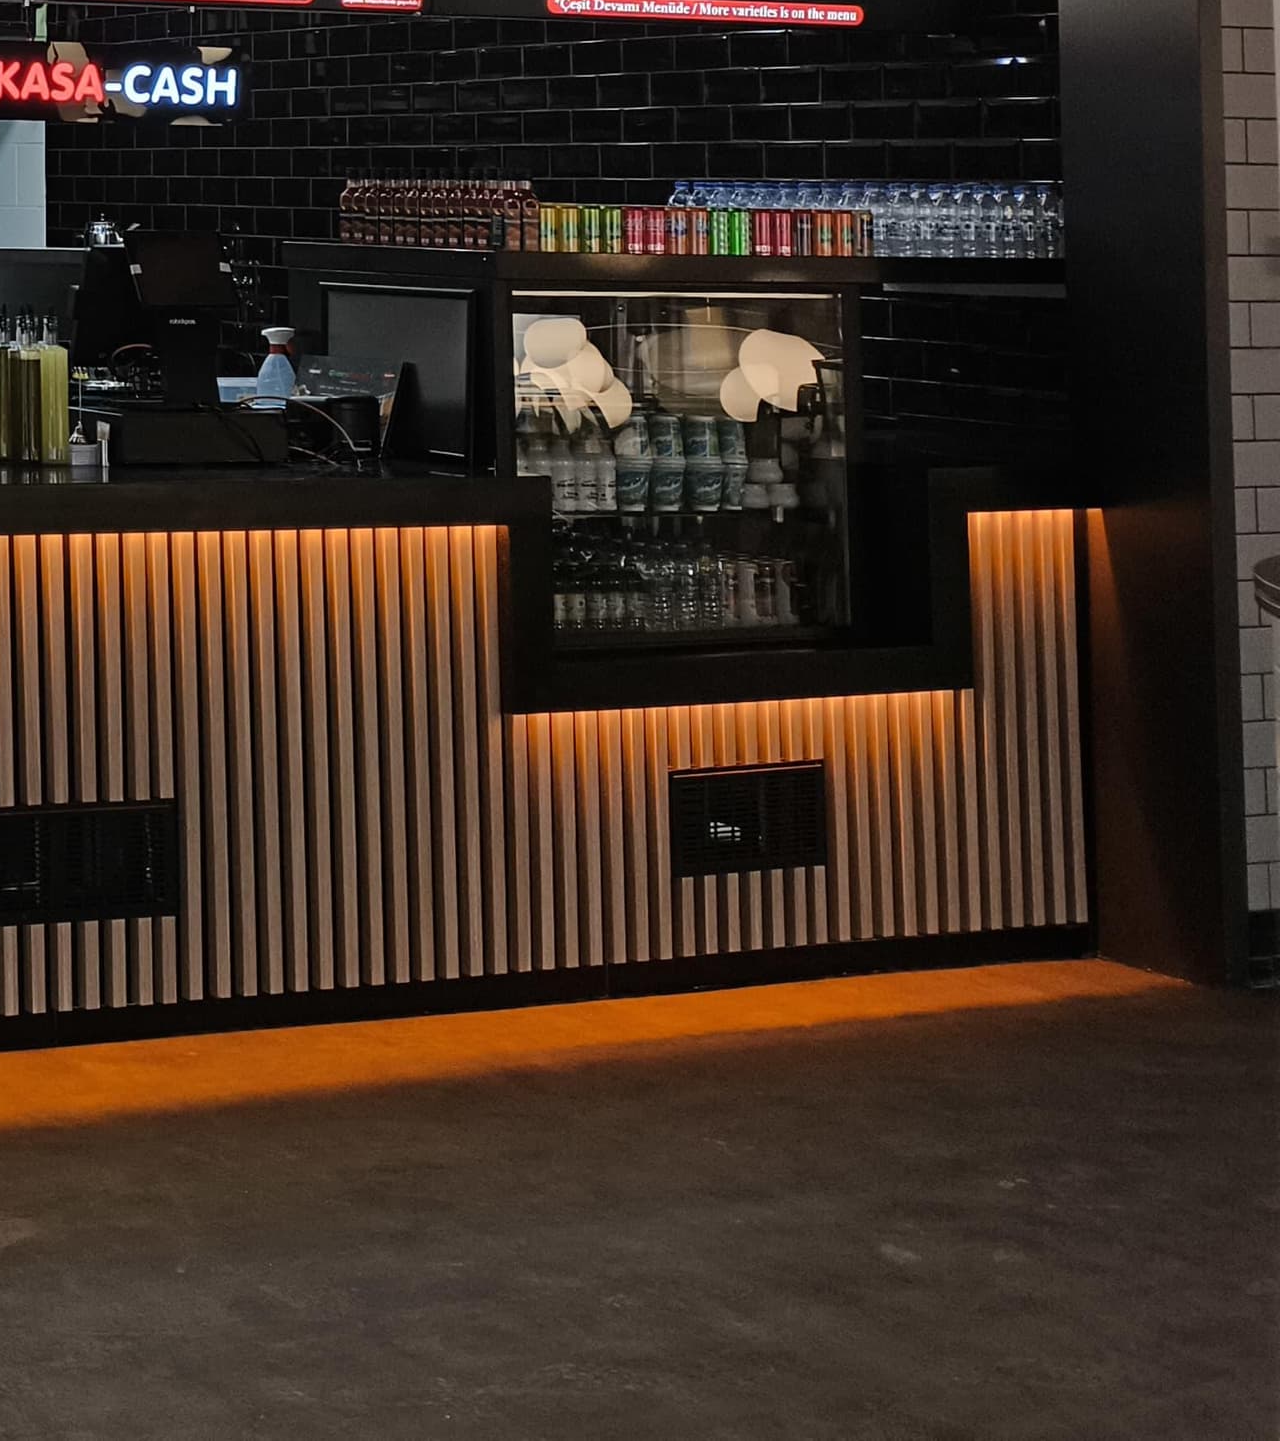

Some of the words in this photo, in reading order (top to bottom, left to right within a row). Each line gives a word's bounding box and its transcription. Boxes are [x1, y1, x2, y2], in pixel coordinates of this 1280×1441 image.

[641, 0, 690, 16] Menüde
[698, 2, 729, 17] More
[731, 4, 778, 19] varieties
[791, 8, 807, 20] on
[807, 7, 825, 20] the
[826, 9, 858, 22] menu
